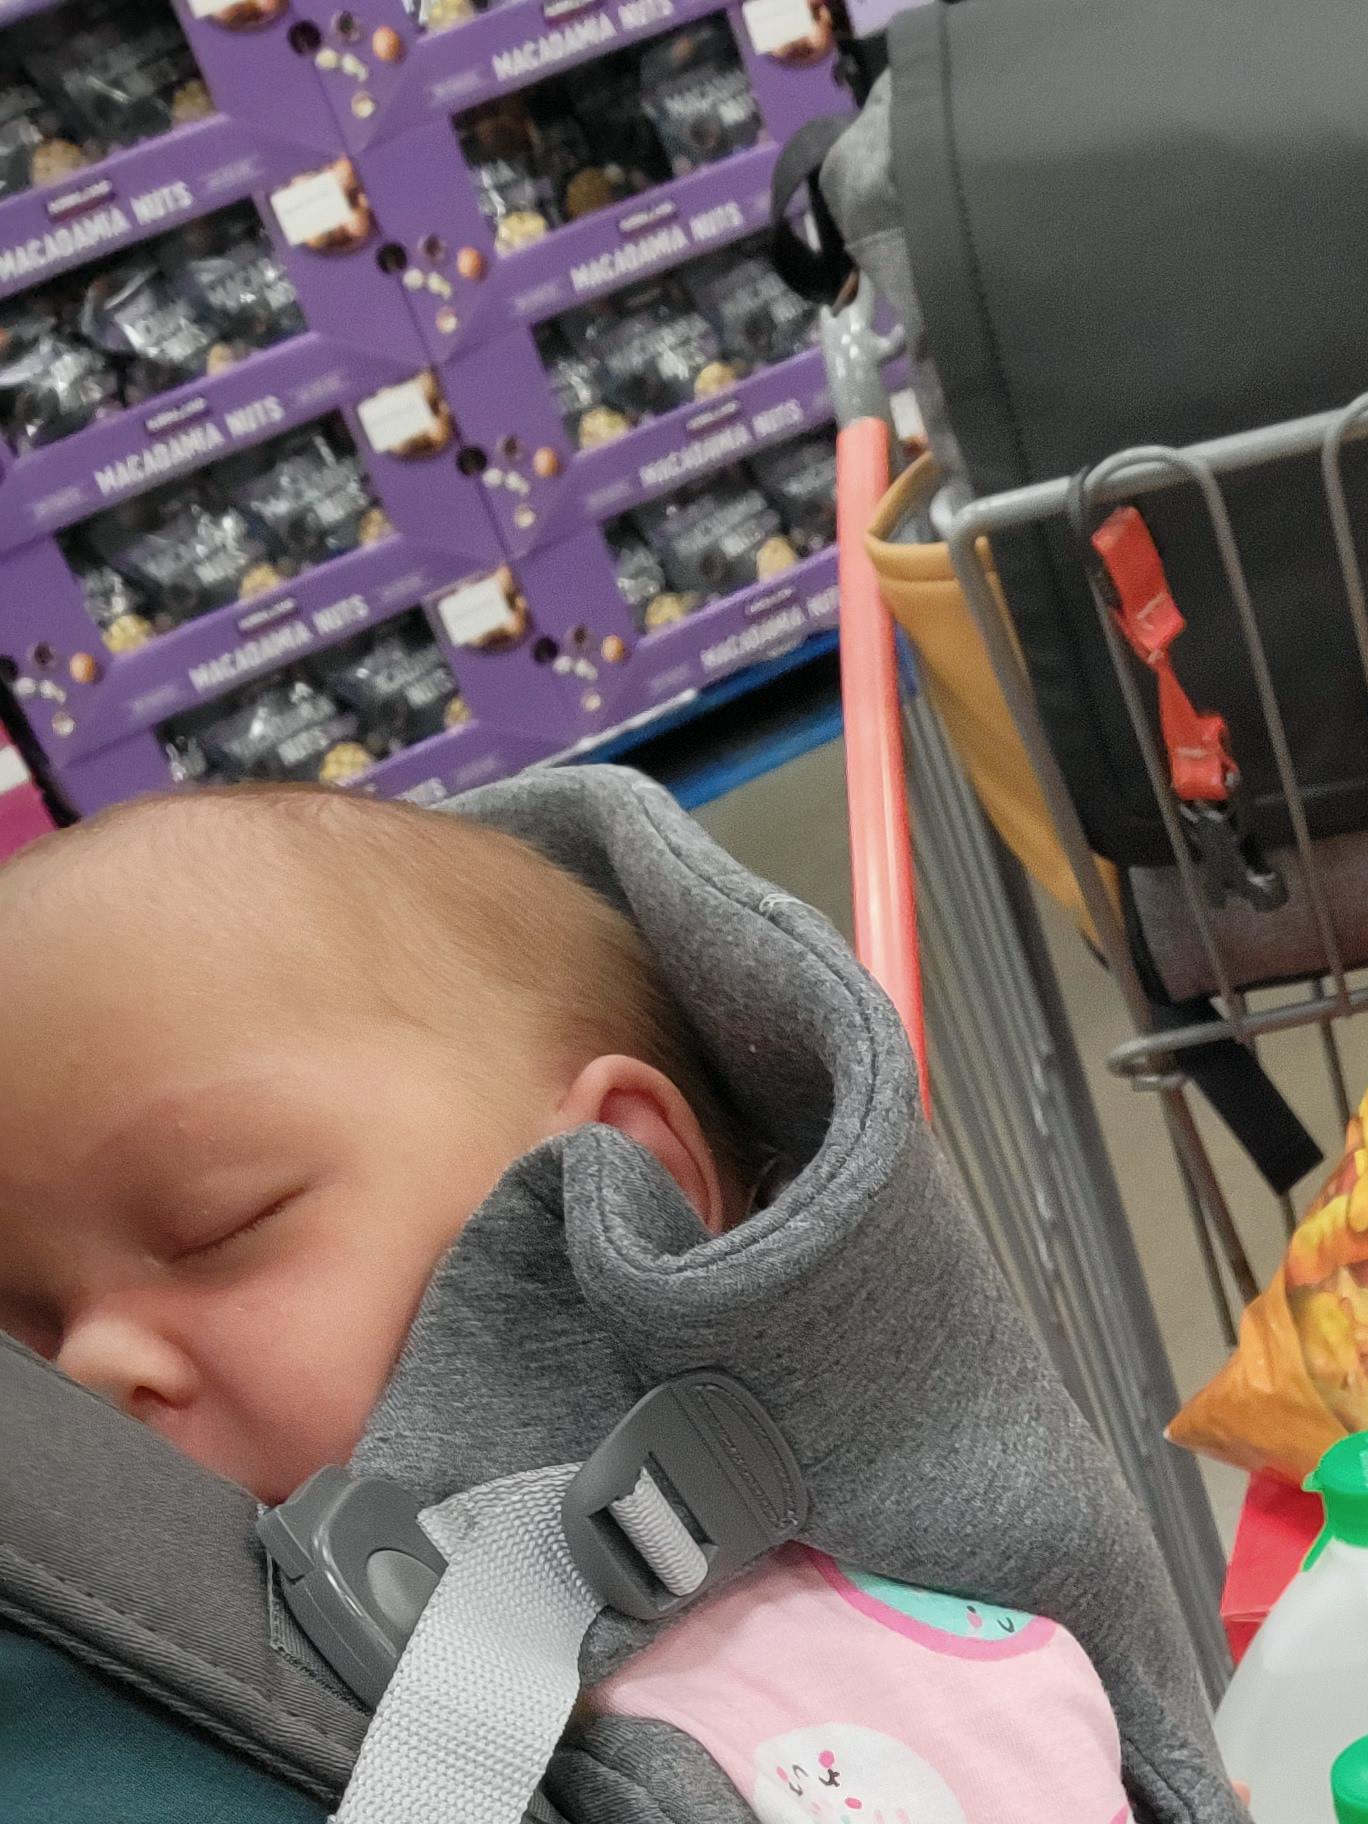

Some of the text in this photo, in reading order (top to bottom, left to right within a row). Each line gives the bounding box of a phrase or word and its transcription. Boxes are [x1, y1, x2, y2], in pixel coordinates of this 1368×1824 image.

[492, 13, 617, 82] MACADAMIA
[130, 180, 194, 226] NUTS
[570, 225, 689, 295] MACADAMIA
[689, 201, 744, 242] NUTS
[94, 422, 225, 497] MACADAMIA
[224, 395, 285, 439] NUTS
[189, 620, 314, 693] MACADAMIA
[312, 593, 370, 637] NUTS
